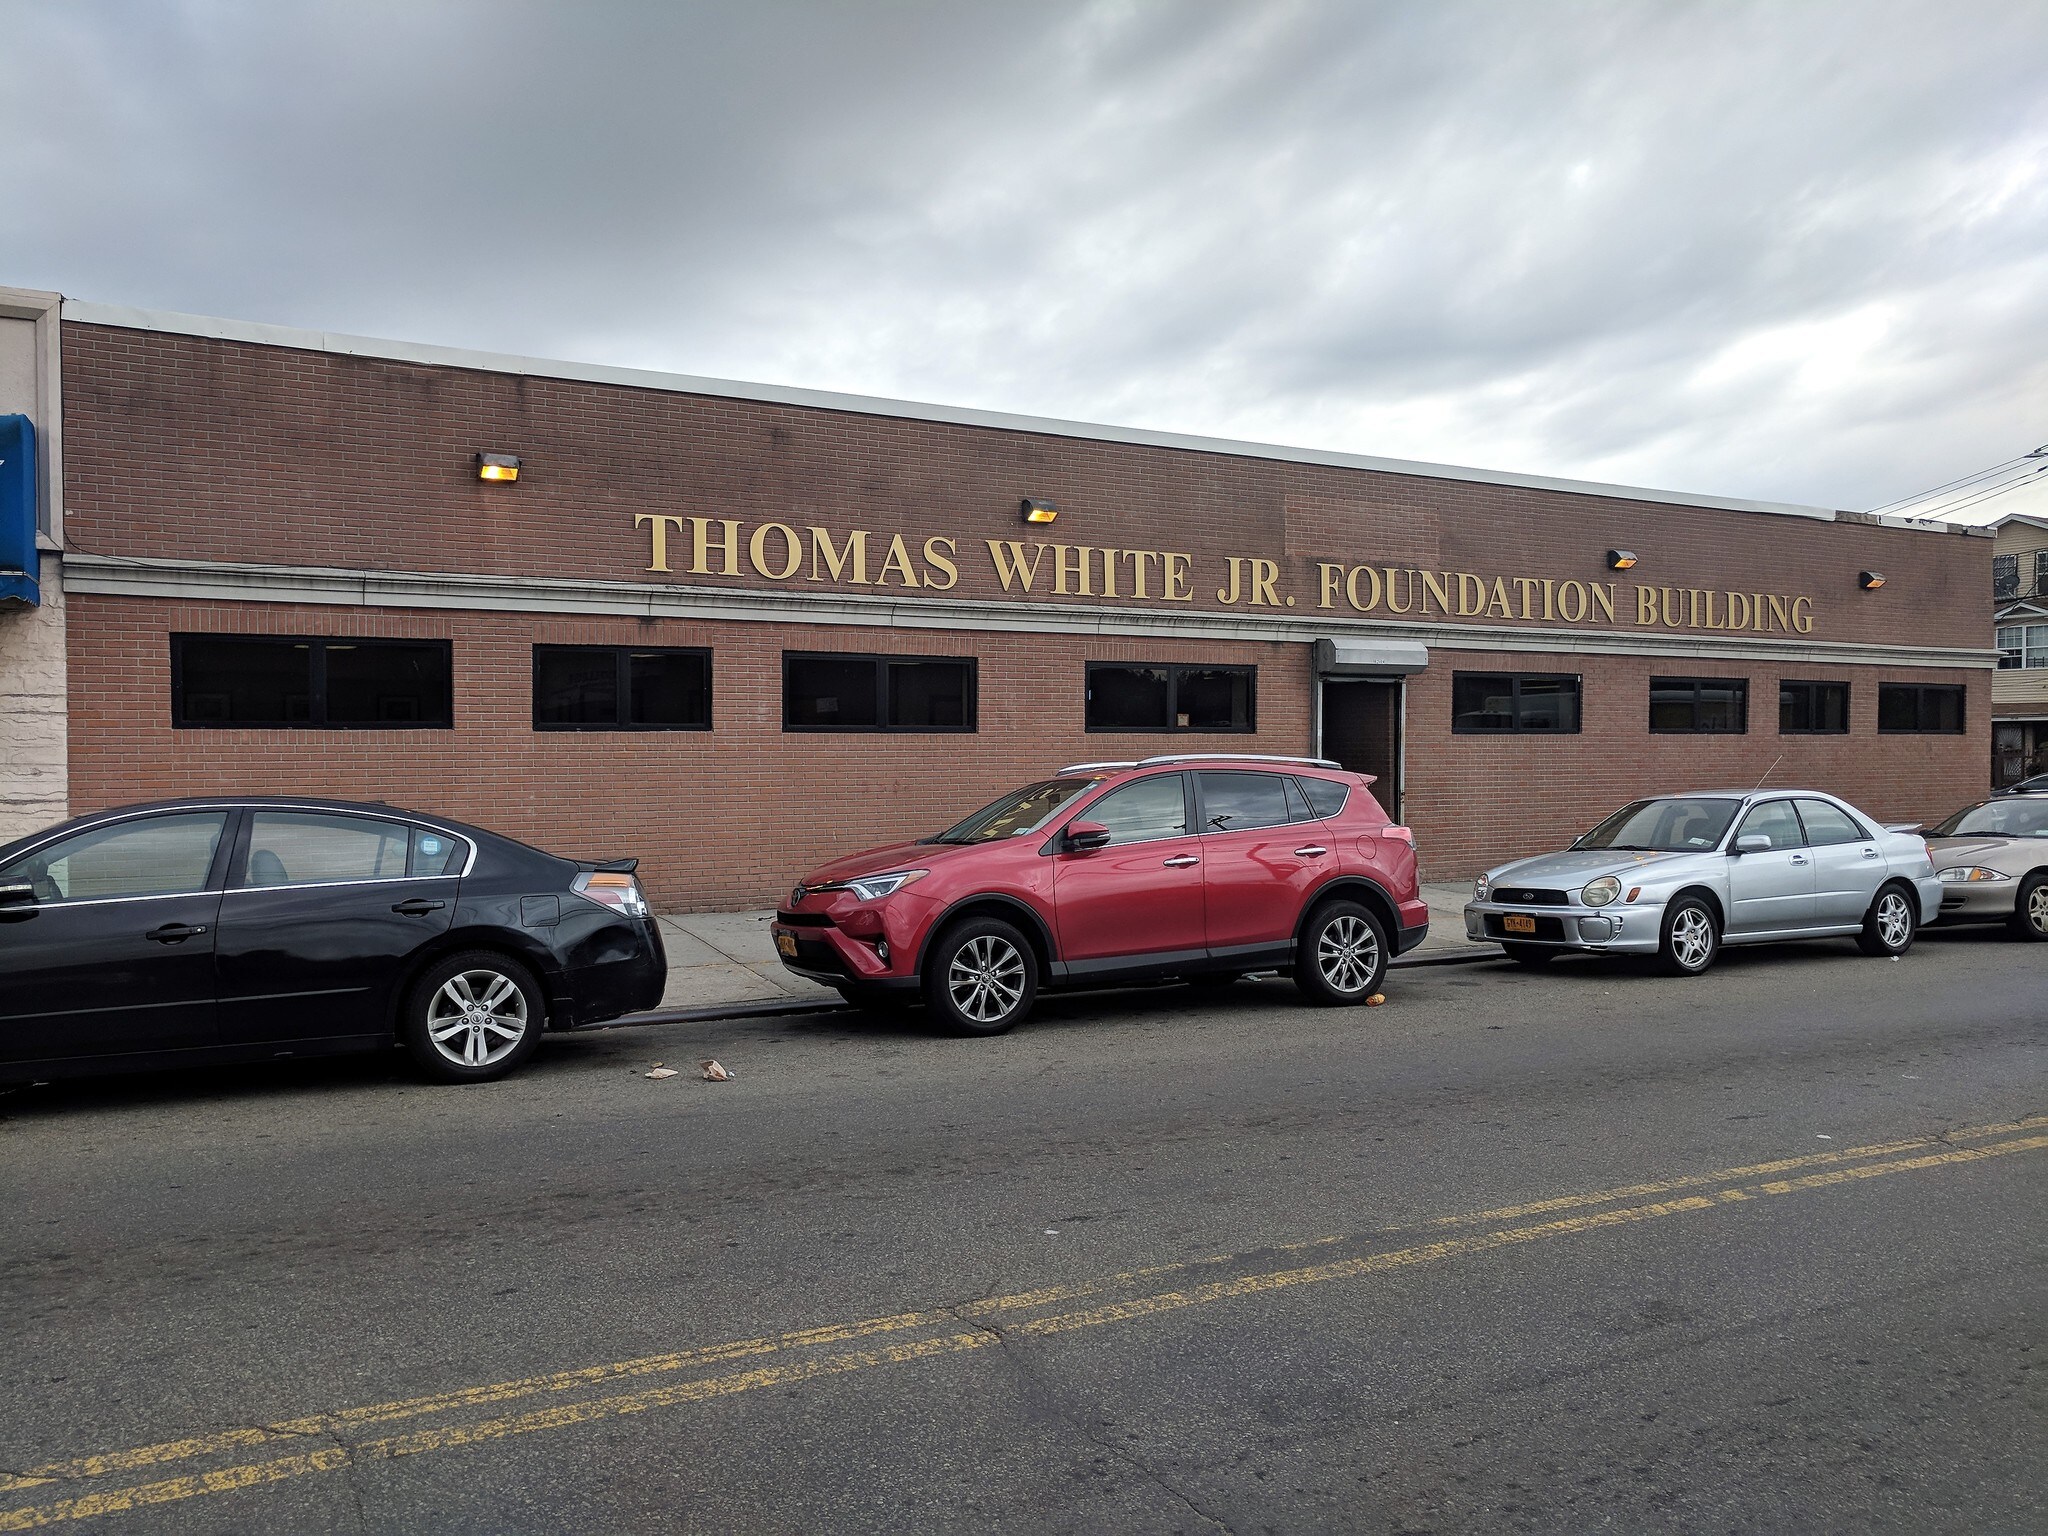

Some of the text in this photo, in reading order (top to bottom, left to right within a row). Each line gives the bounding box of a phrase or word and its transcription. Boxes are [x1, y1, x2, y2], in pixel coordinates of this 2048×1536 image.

[634, 513, 1814, 634] THOMAS WHITE JR. FOUNDATION BUILDING
